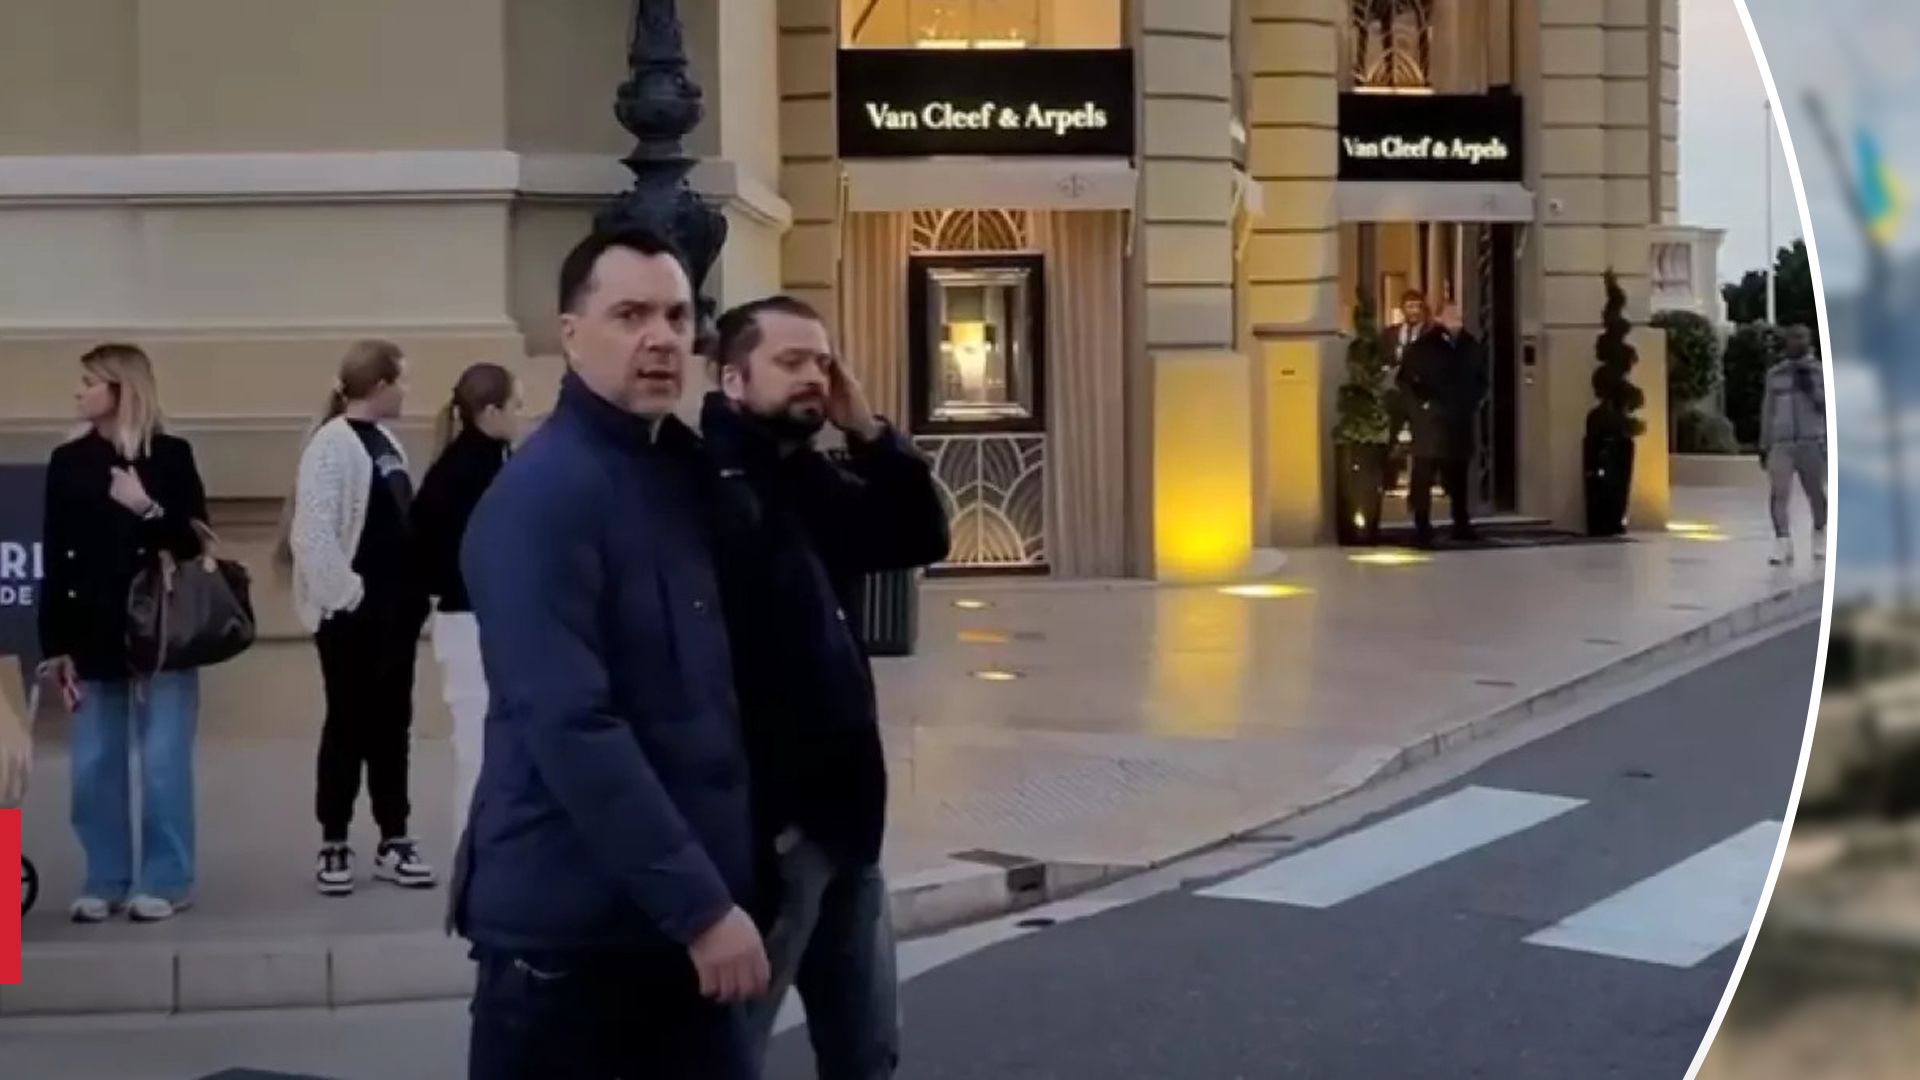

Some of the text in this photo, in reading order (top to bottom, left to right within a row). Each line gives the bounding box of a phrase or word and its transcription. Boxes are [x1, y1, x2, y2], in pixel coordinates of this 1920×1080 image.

[866, 102, 1107, 135] Van Cleef & Arpels
[1343, 136, 1508, 165] Van Cleef & Arpels
[0, 585, 32, 606] DE
